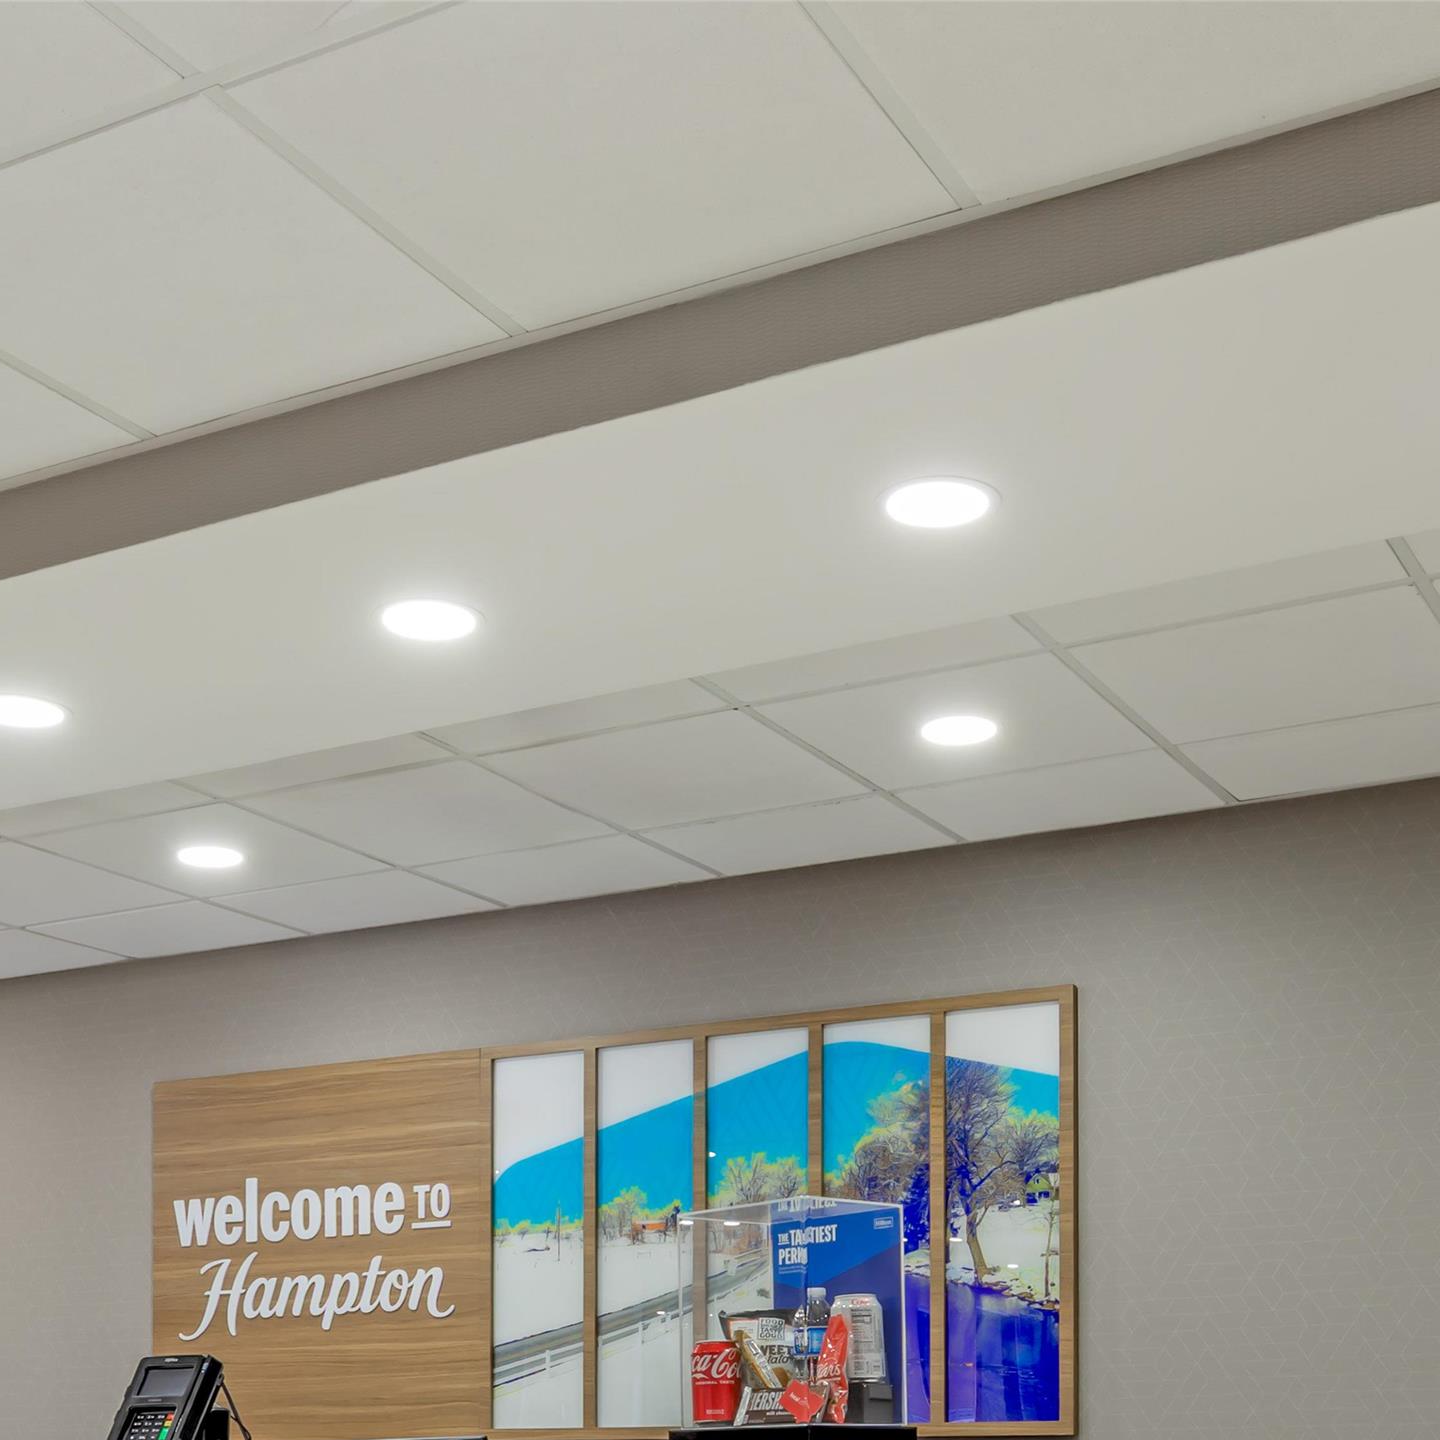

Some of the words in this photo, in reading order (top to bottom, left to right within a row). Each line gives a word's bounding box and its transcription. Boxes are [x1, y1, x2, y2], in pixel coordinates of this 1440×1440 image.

[173, 1177, 405, 1247] welcome
[412, 1183, 451, 1229] TO
[778, 1233, 789, 1245] THE
[178, 1251, 456, 1341] Hampton
[760, 1345, 793, 1356] WEET
